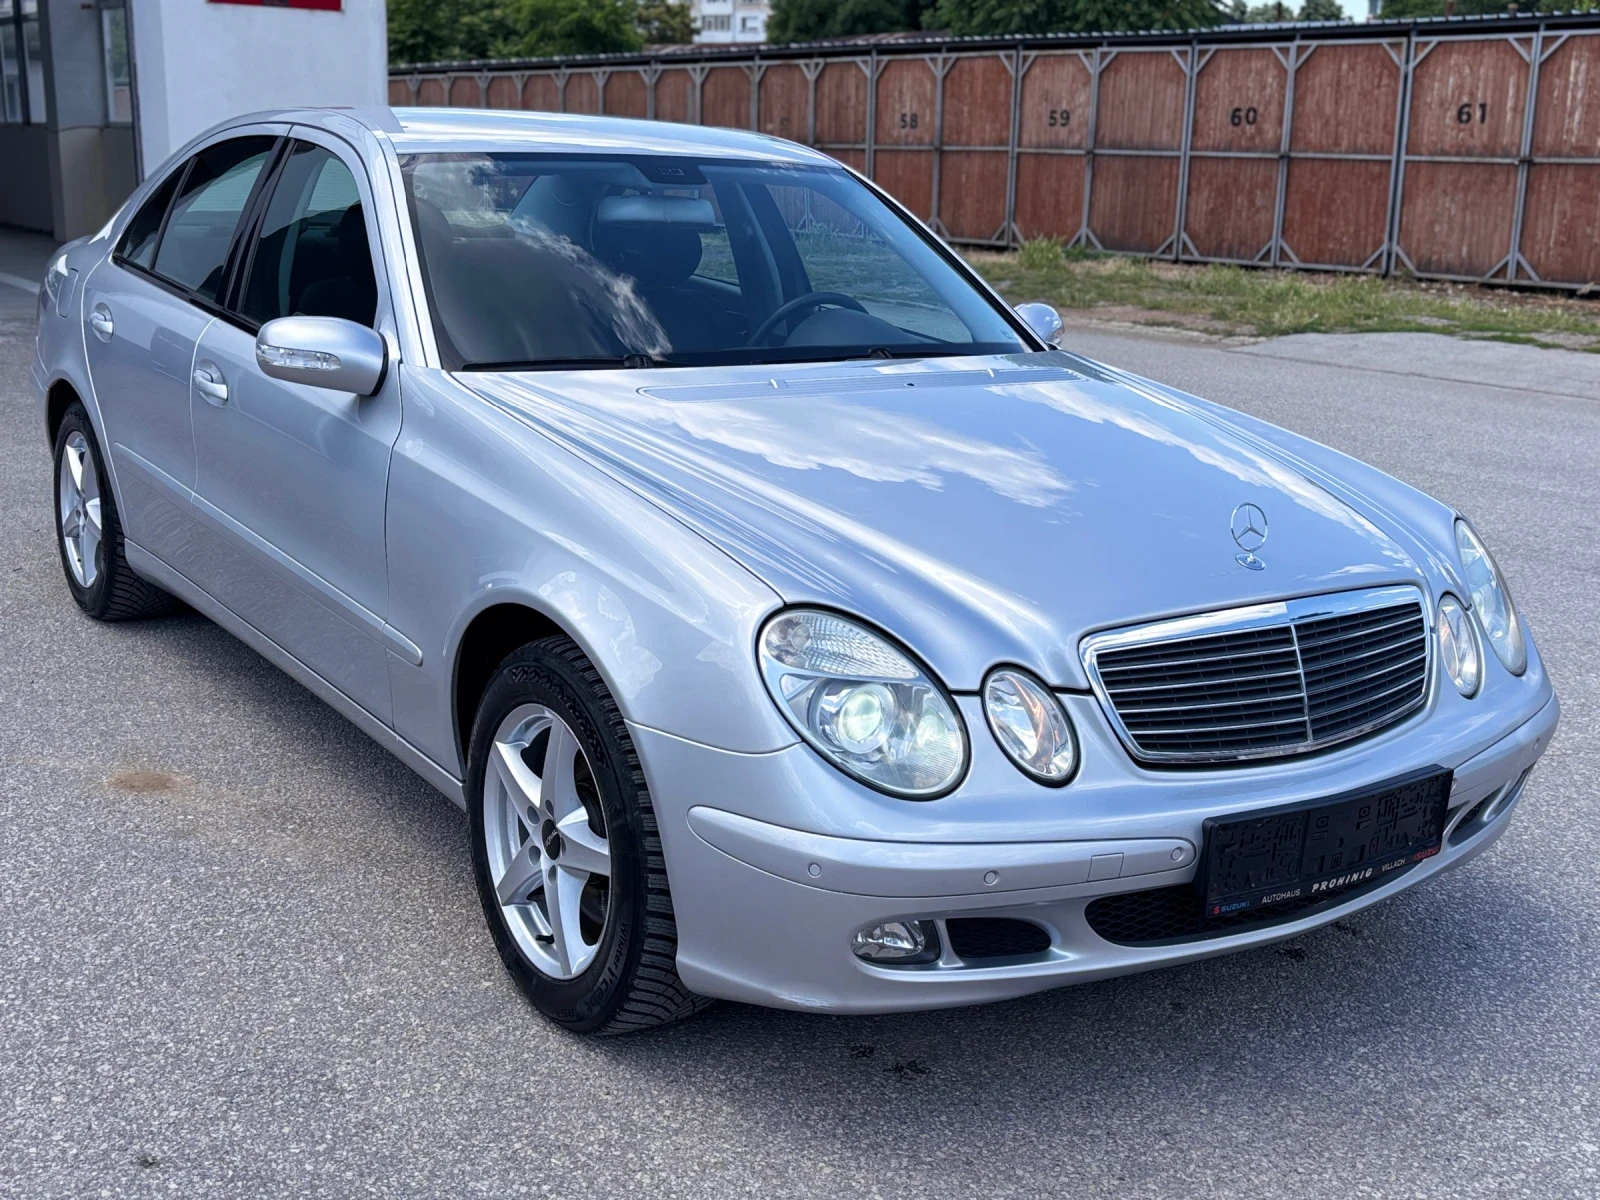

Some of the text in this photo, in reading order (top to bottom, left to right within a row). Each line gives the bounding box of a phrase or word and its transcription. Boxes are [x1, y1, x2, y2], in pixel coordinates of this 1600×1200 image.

[900, 113, 918, 129] 58
[1048, 109, 1070, 127] 59
[1230, 107, 1258, 127] 60
[1457, 103, 1487, 124] 61
[1221, 846, 1440, 912] SUZUKI AUTOHAUS PROHINIG VILLACH ISUZU
